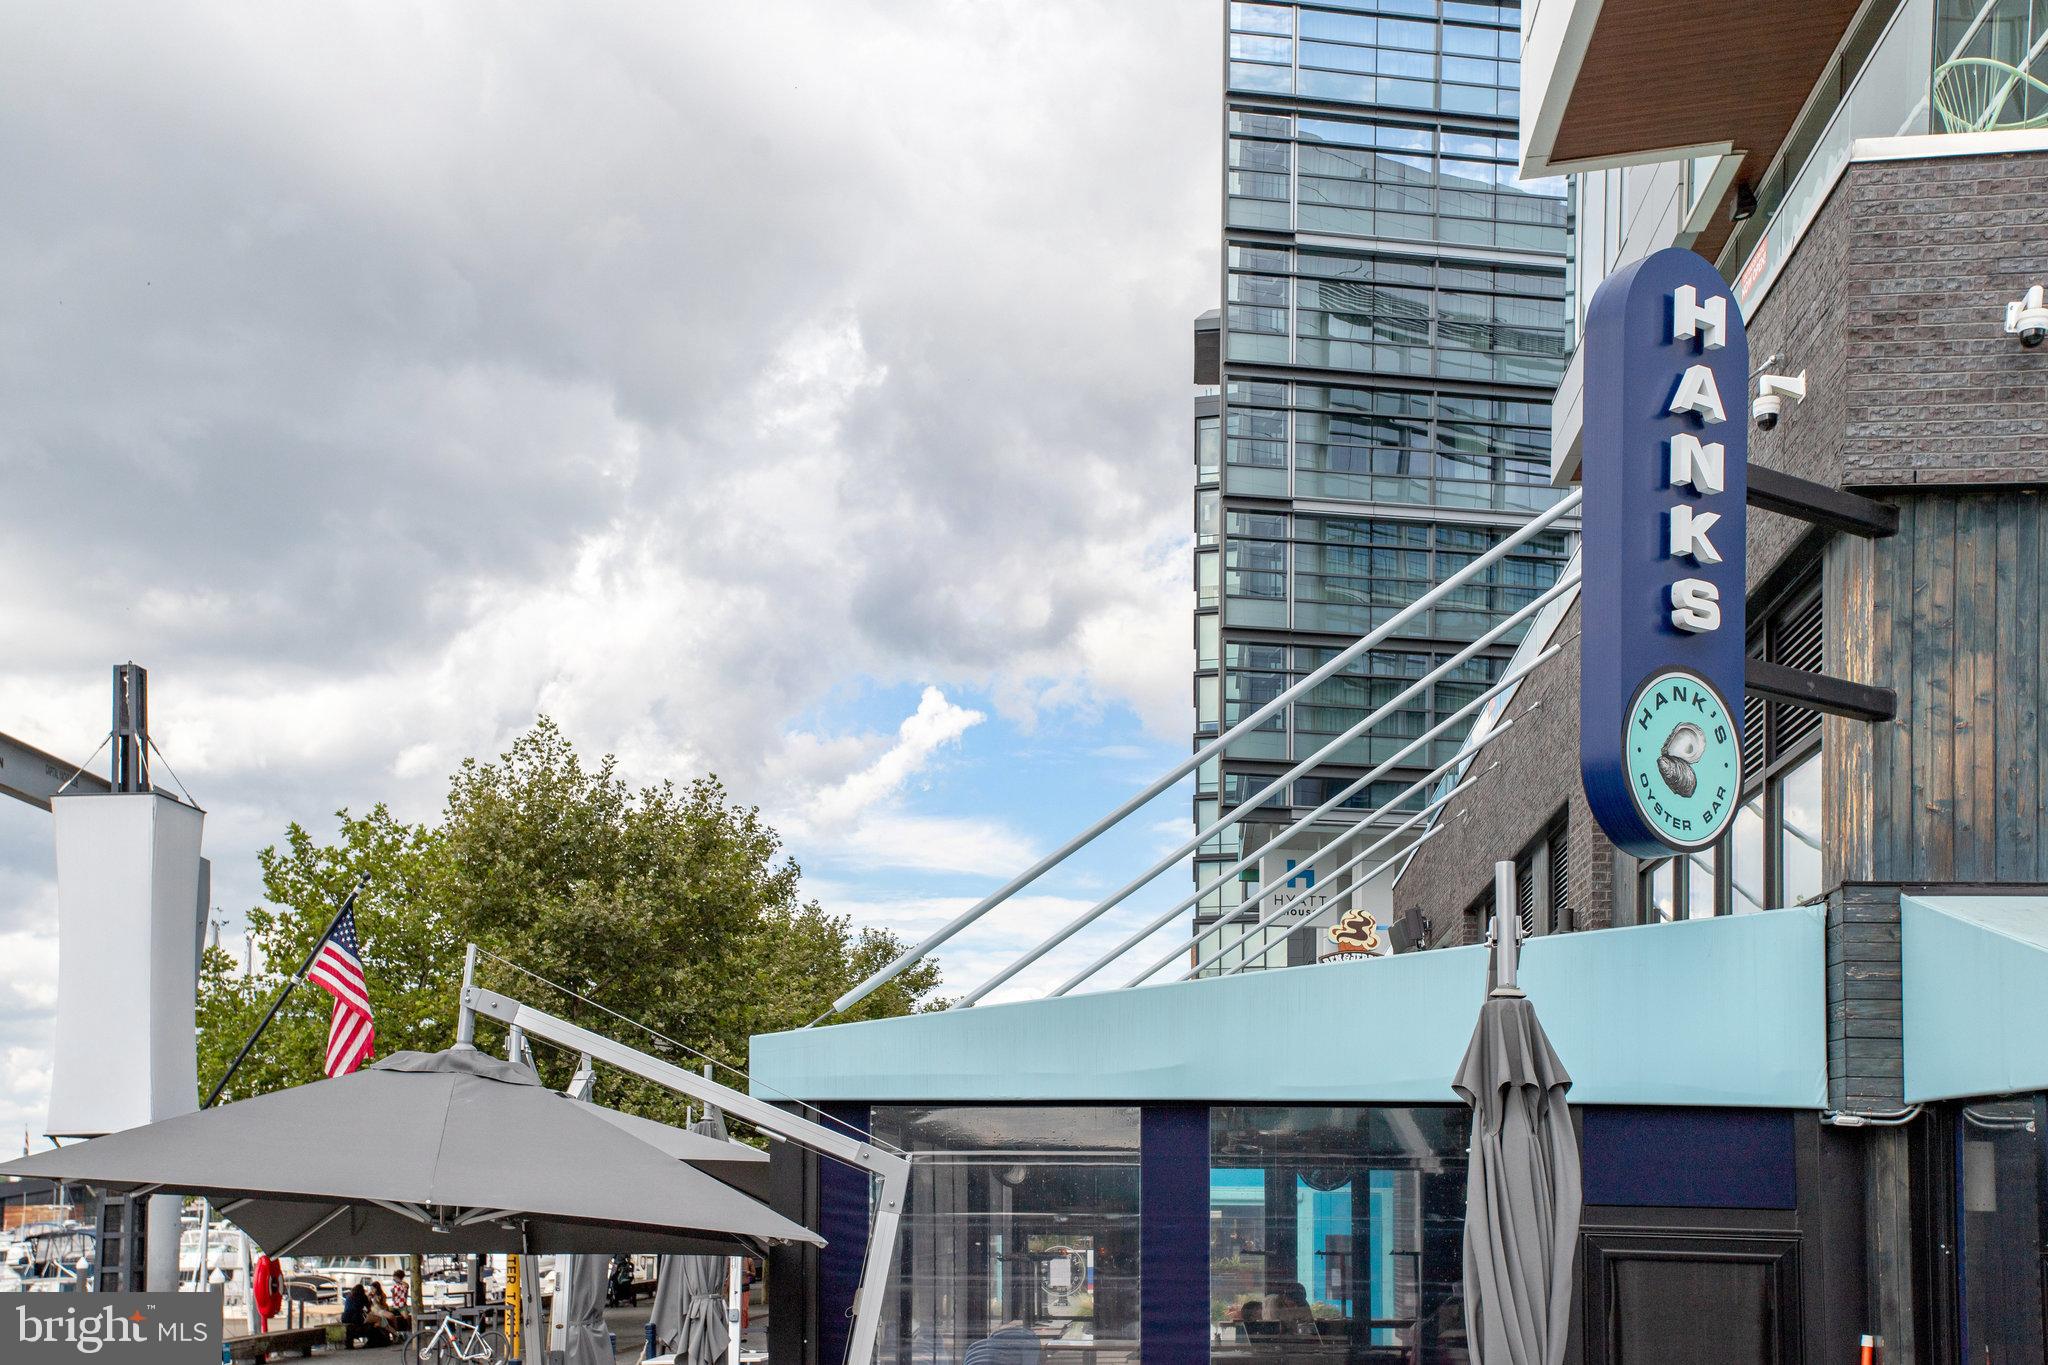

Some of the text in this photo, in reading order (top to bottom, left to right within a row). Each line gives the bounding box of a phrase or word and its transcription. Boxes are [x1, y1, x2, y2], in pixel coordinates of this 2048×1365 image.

[1669, 284, 1727, 633] HANKS
[1638, 686, 1728, 745] HANK'S
[1640, 772, 1727, 831] OYSTER BAR
[1283, 908, 1318, 916] OUS
